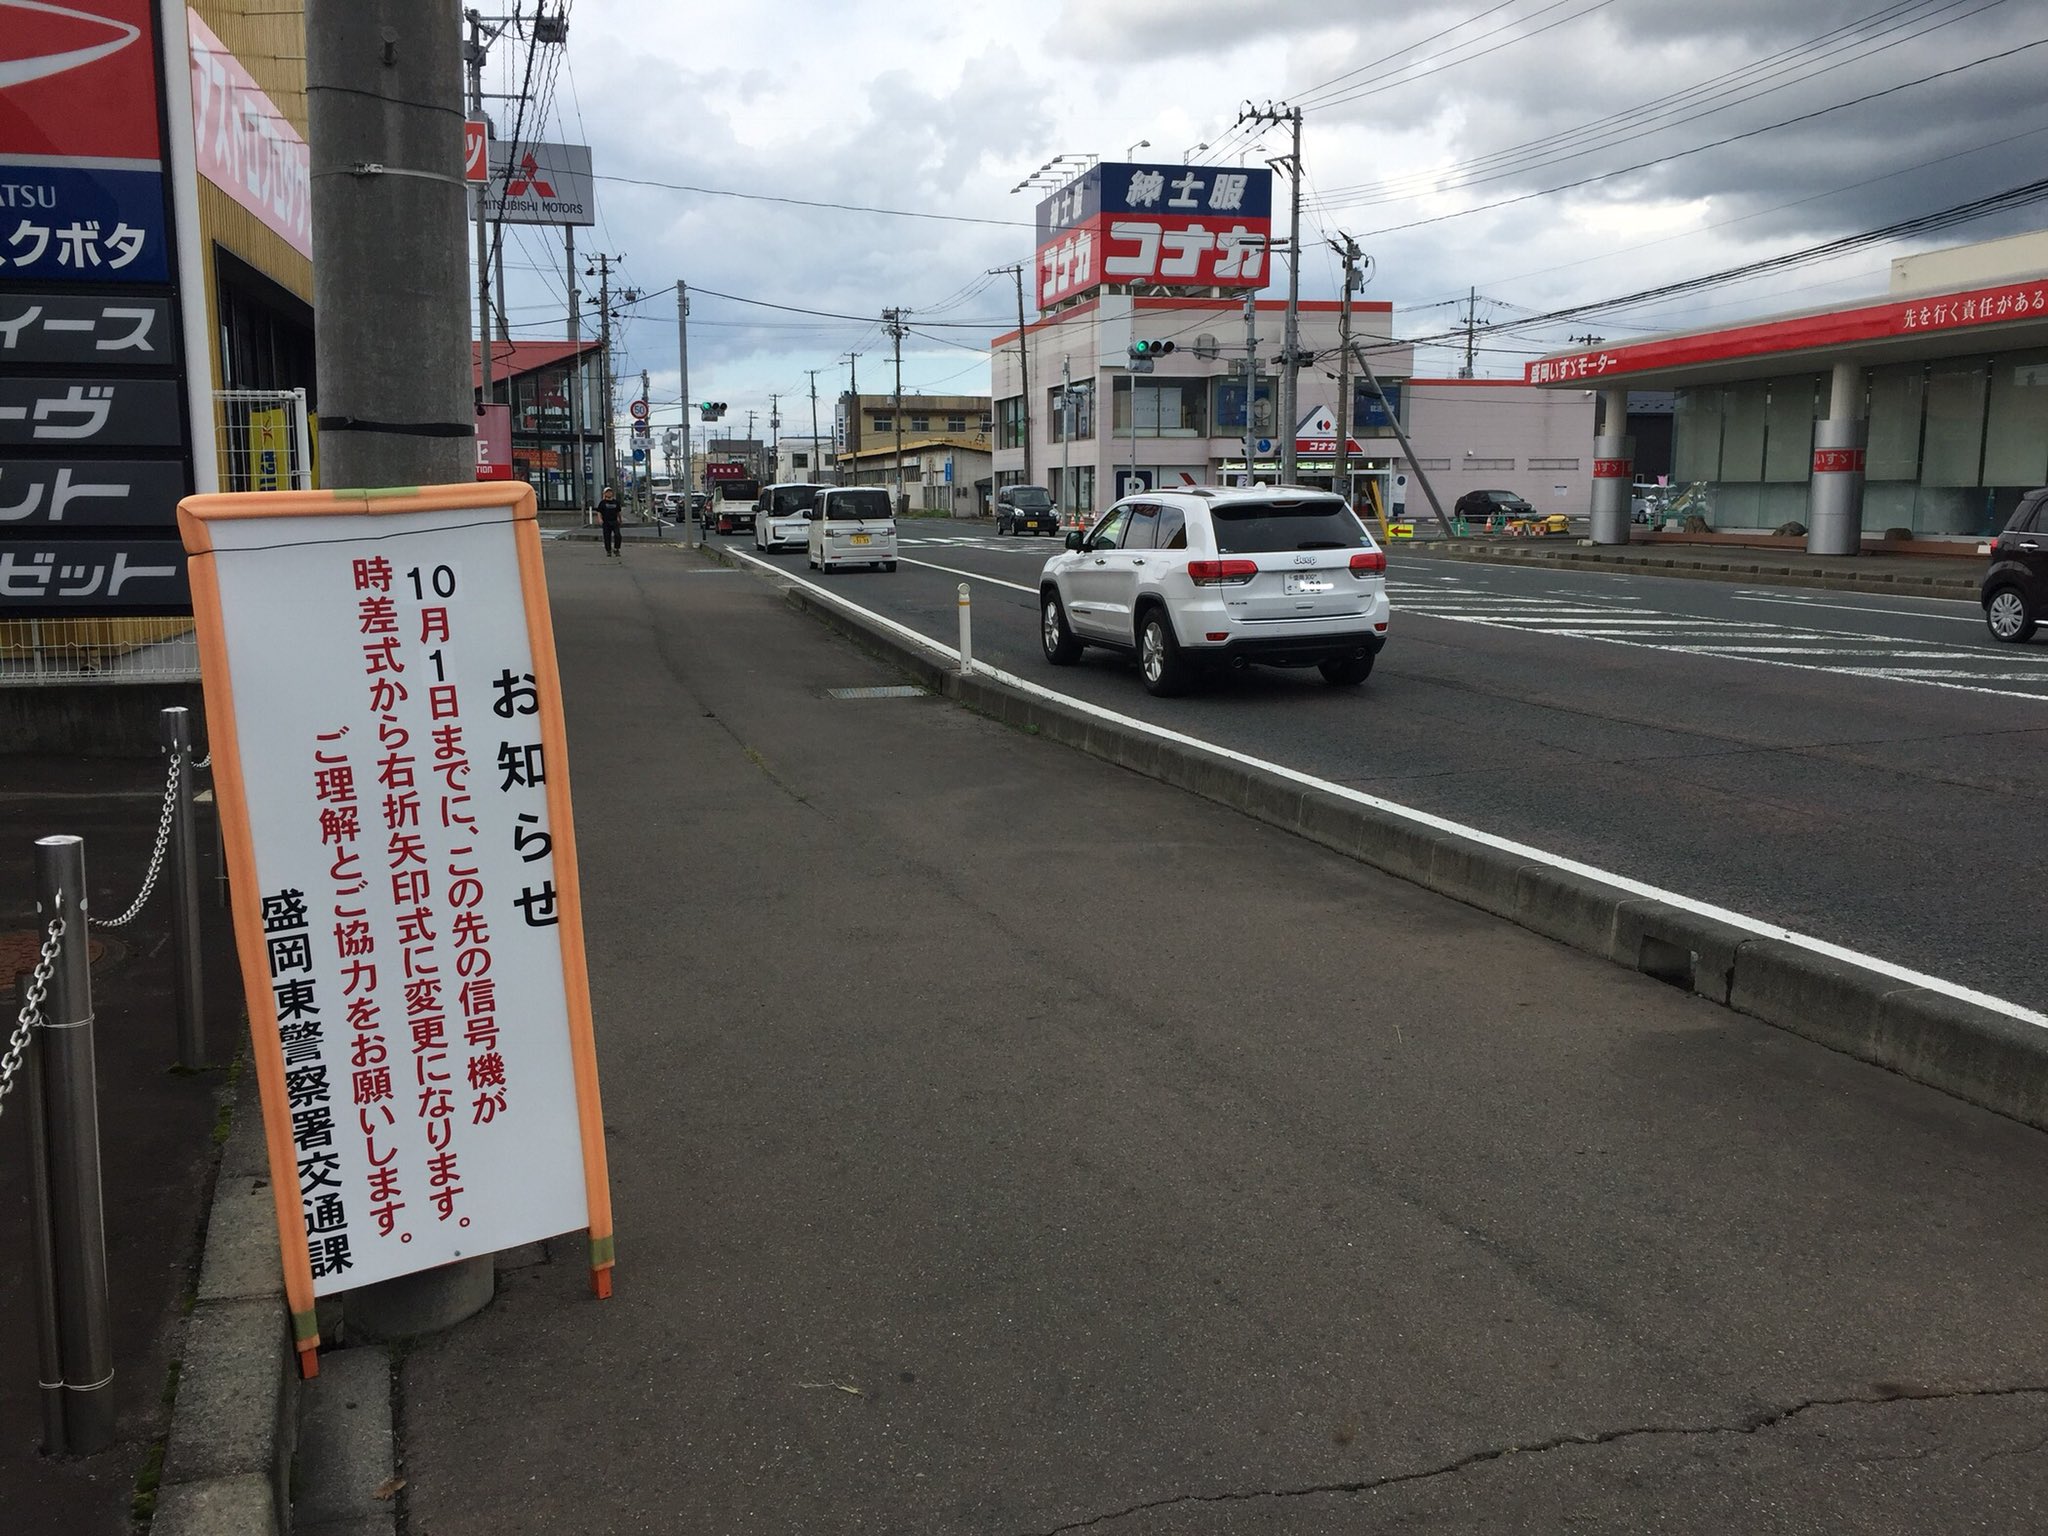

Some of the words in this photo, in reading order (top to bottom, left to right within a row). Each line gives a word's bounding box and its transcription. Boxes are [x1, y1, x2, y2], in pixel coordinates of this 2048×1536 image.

[542, 201, 583, 214] MOTORS
[1126, 170, 1248, 211] 紳士服
[0, 219, 146, 270] クボタ
[1043, 229, 1091, 299] コナカ
[1104, 222, 1267, 278] コナカ
[1903, 290, 2044, 329] 先を行く責任がある
[634, 405, 646, 415] 50
[1294, 555, 1318, 565] Jeep
[492, 669, 559, 928] お知らせ
[314, 726, 412, 1244] ご理解とご協力をお願いします。
[261, 888, 353, 1280] 盛岡東警察署交通課
